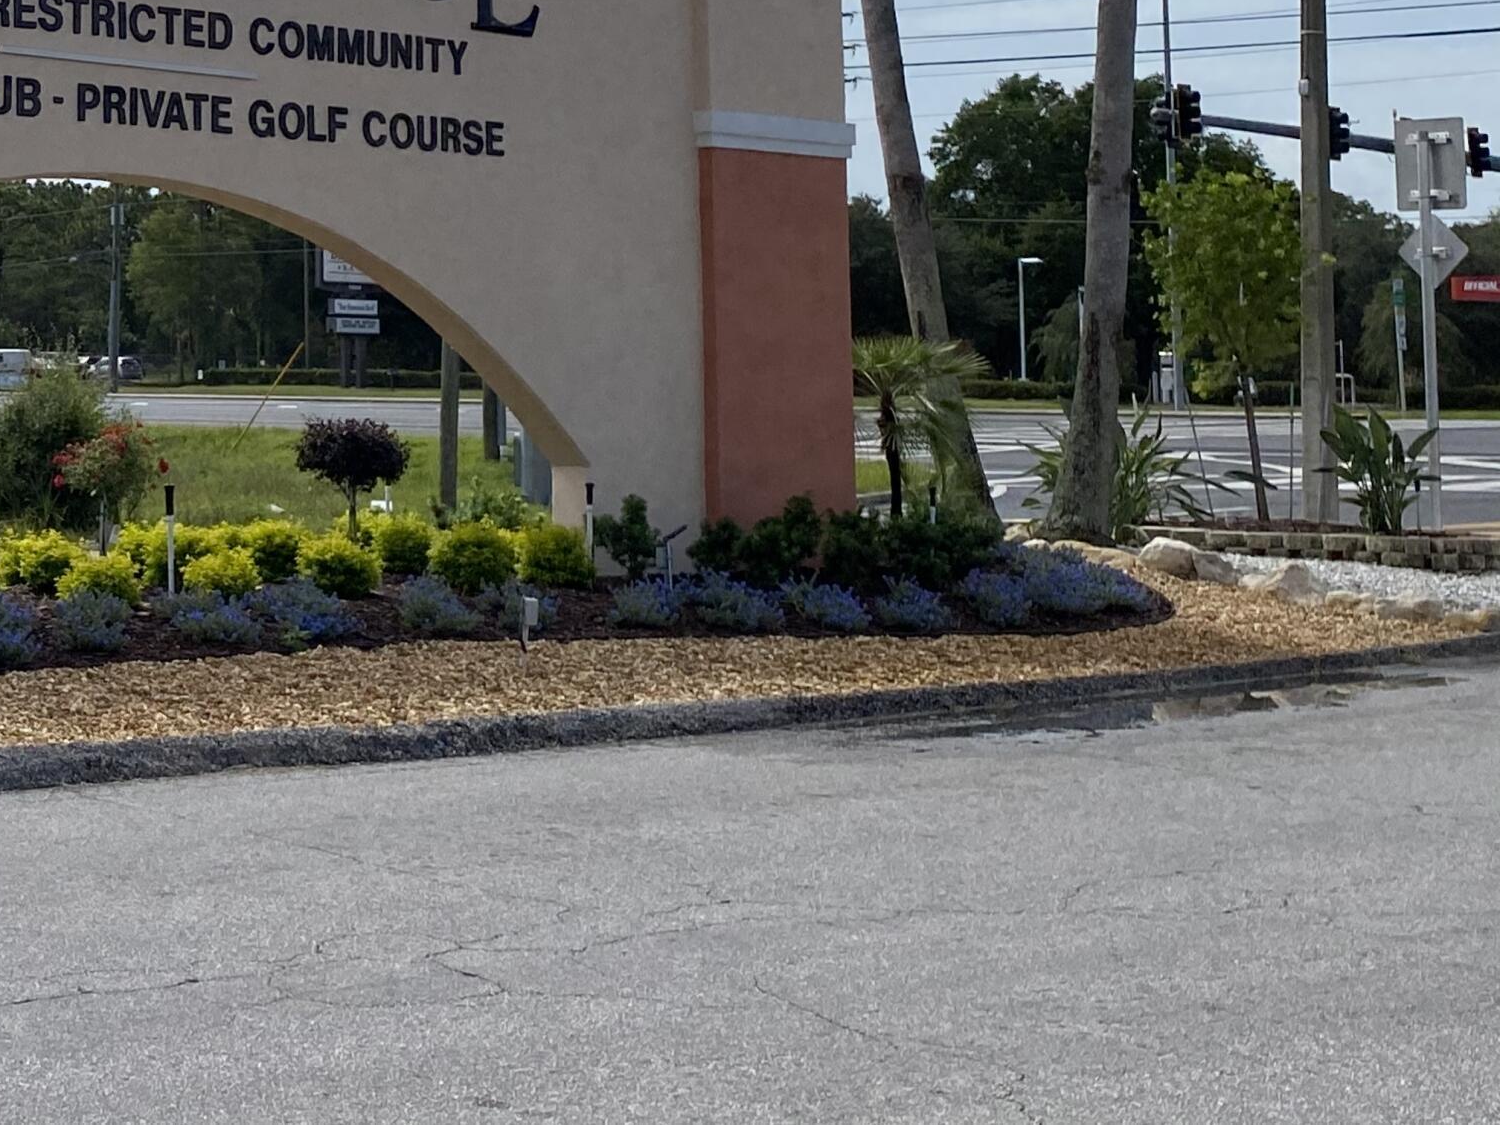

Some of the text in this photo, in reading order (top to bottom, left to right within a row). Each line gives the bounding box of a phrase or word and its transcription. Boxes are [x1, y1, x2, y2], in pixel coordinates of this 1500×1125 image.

[248, 16, 469, 77] COMMUNITY
[76, 82, 234, 136] PRIVATE
[247, 98, 349, 144] GOLF
[361, 110, 506, 158] COURSE
